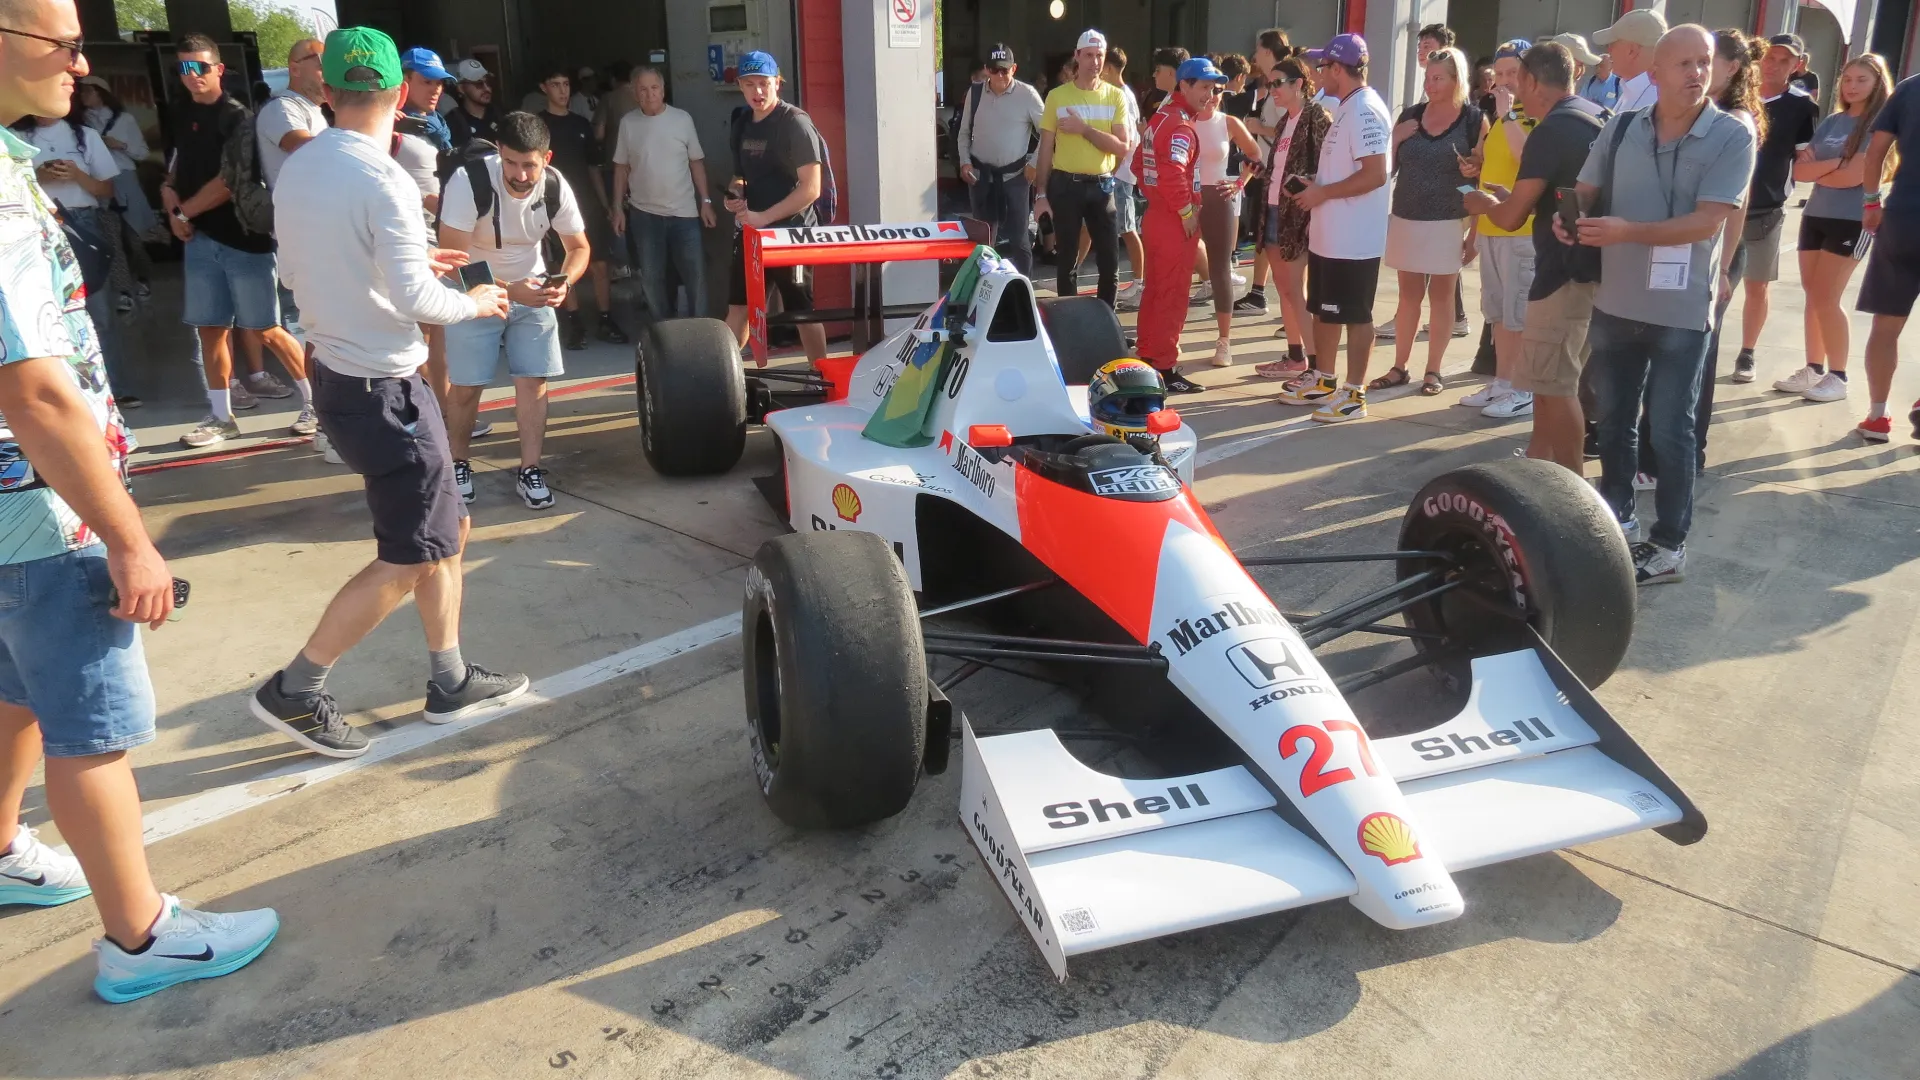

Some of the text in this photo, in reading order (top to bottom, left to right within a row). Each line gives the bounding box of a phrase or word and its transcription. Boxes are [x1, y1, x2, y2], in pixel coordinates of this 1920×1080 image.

[991, 51, 1006, 60] NYC
[786, 225, 931, 245] Marlboro
[869, 474, 954, 494] COURTAULDS
[951, 442, 996, 499] Marlboro
[1278, 719, 1381, 798] 27
[1410, 716, 1556, 761] Shell
[1042, 783, 1211, 830] Shell
[973, 811, 1045, 934] GOODYEAR
[549, 1050, 577, 1068] 5
[697, 974, 722, 991] 2
[828, 910, 848, 923] 1
[861, 889, 886, 904] 2
[900, 870, 922, 883] 3
